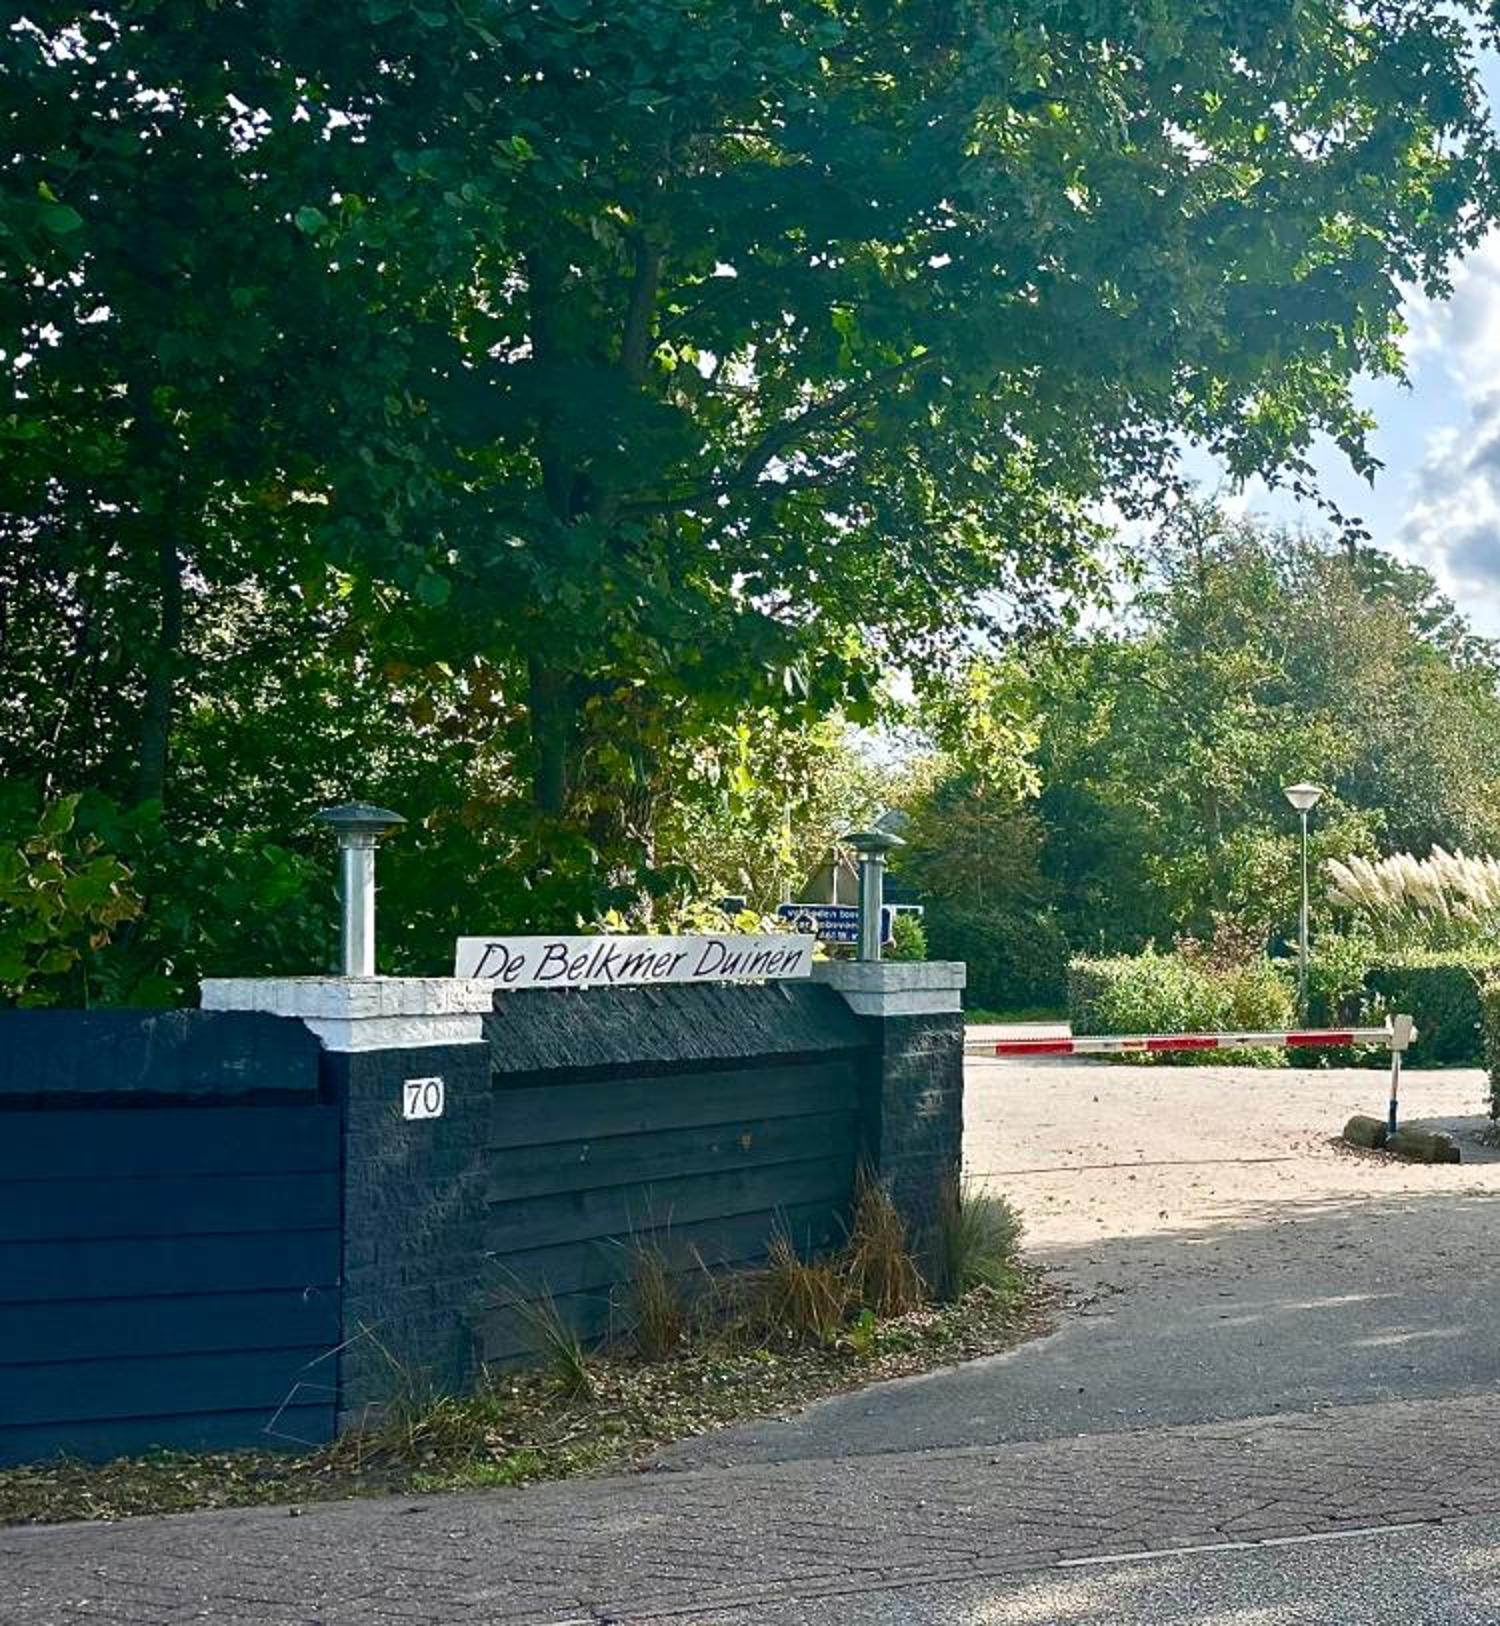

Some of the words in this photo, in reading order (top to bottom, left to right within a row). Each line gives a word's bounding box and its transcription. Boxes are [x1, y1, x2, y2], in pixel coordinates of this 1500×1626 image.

[471, 942, 525, 983] De
[532, 942, 688, 983] Belkmer
[693, 940, 804, 978] Duinen
[407, 1081, 441, 1115] 70
